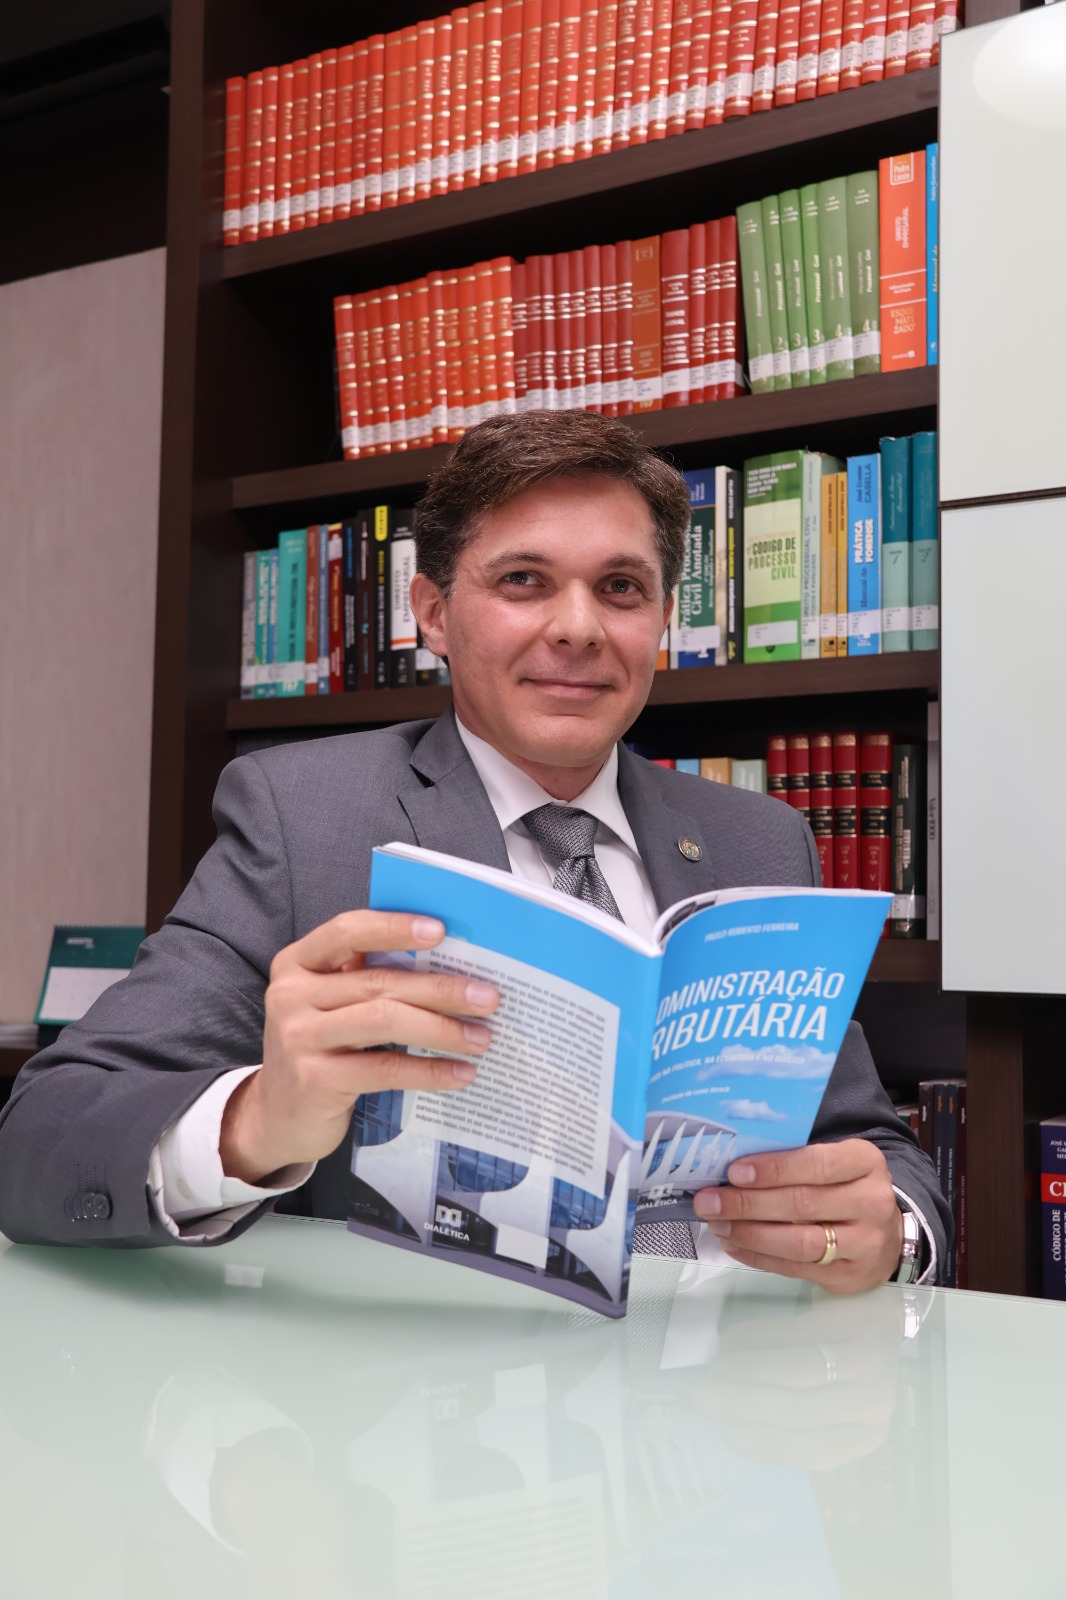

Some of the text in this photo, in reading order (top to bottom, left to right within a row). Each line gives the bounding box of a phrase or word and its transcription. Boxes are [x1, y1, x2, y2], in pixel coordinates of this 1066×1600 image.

[812, 327, 820, 343] 3
[864, 464, 872, 502] CASELLA
[786, 537, 796, 550] DE
[853, 520, 864, 564] PRÁTICA
[864, 518, 874, 562] FORENSE
[691, 524, 702, 616] Civil Anotada
[748, 551, 796, 570] PROCESSO
[772, 566, 796, 580] CIVIL
[860, 576, 868, 608] Manual
[762, 922, 800, 934] FERREIRA
[656, 966, 846, 1026] DMINISTRAÇÃO
[651, 996, 828, 1062] RIBUTÁRIA
[704, 1056, 714, 1064] NA
[763, 1054, 774, 1063] NO
[636, 1198, 678, 1212] DIALÉTICA
[424, 1222, 470, 1242] DIALÉTICA
[1052, 1209, 1062, 1262] CÓDIGO DE
